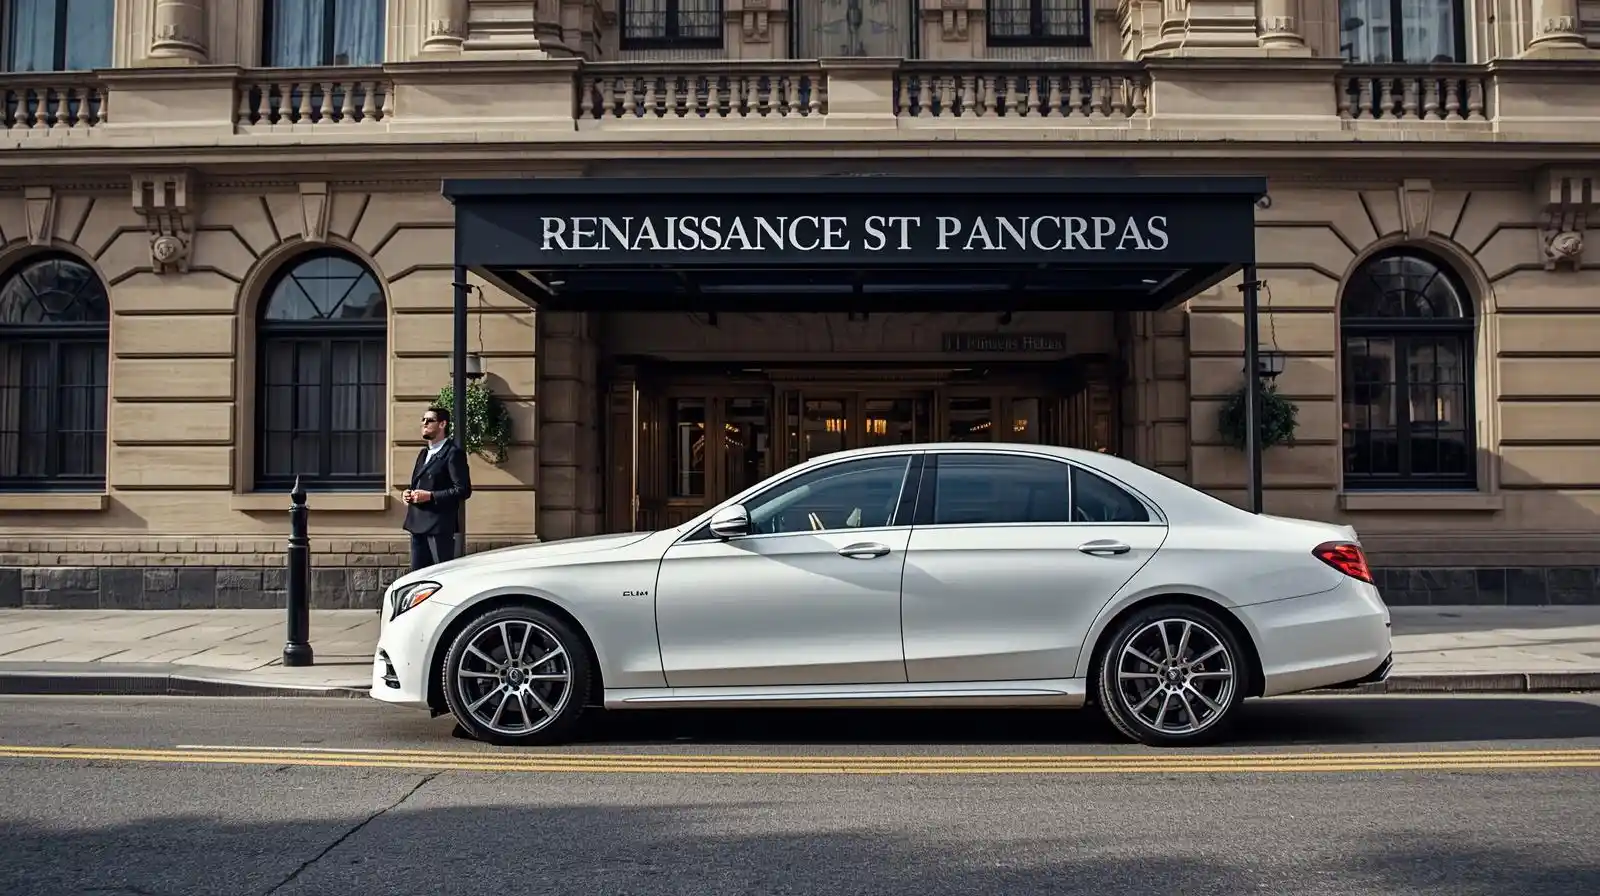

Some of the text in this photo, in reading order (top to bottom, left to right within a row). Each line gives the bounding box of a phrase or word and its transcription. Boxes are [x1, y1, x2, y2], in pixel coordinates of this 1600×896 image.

[539, 215, 1169, 251] RENAISSANCE ST PANCRPAS
